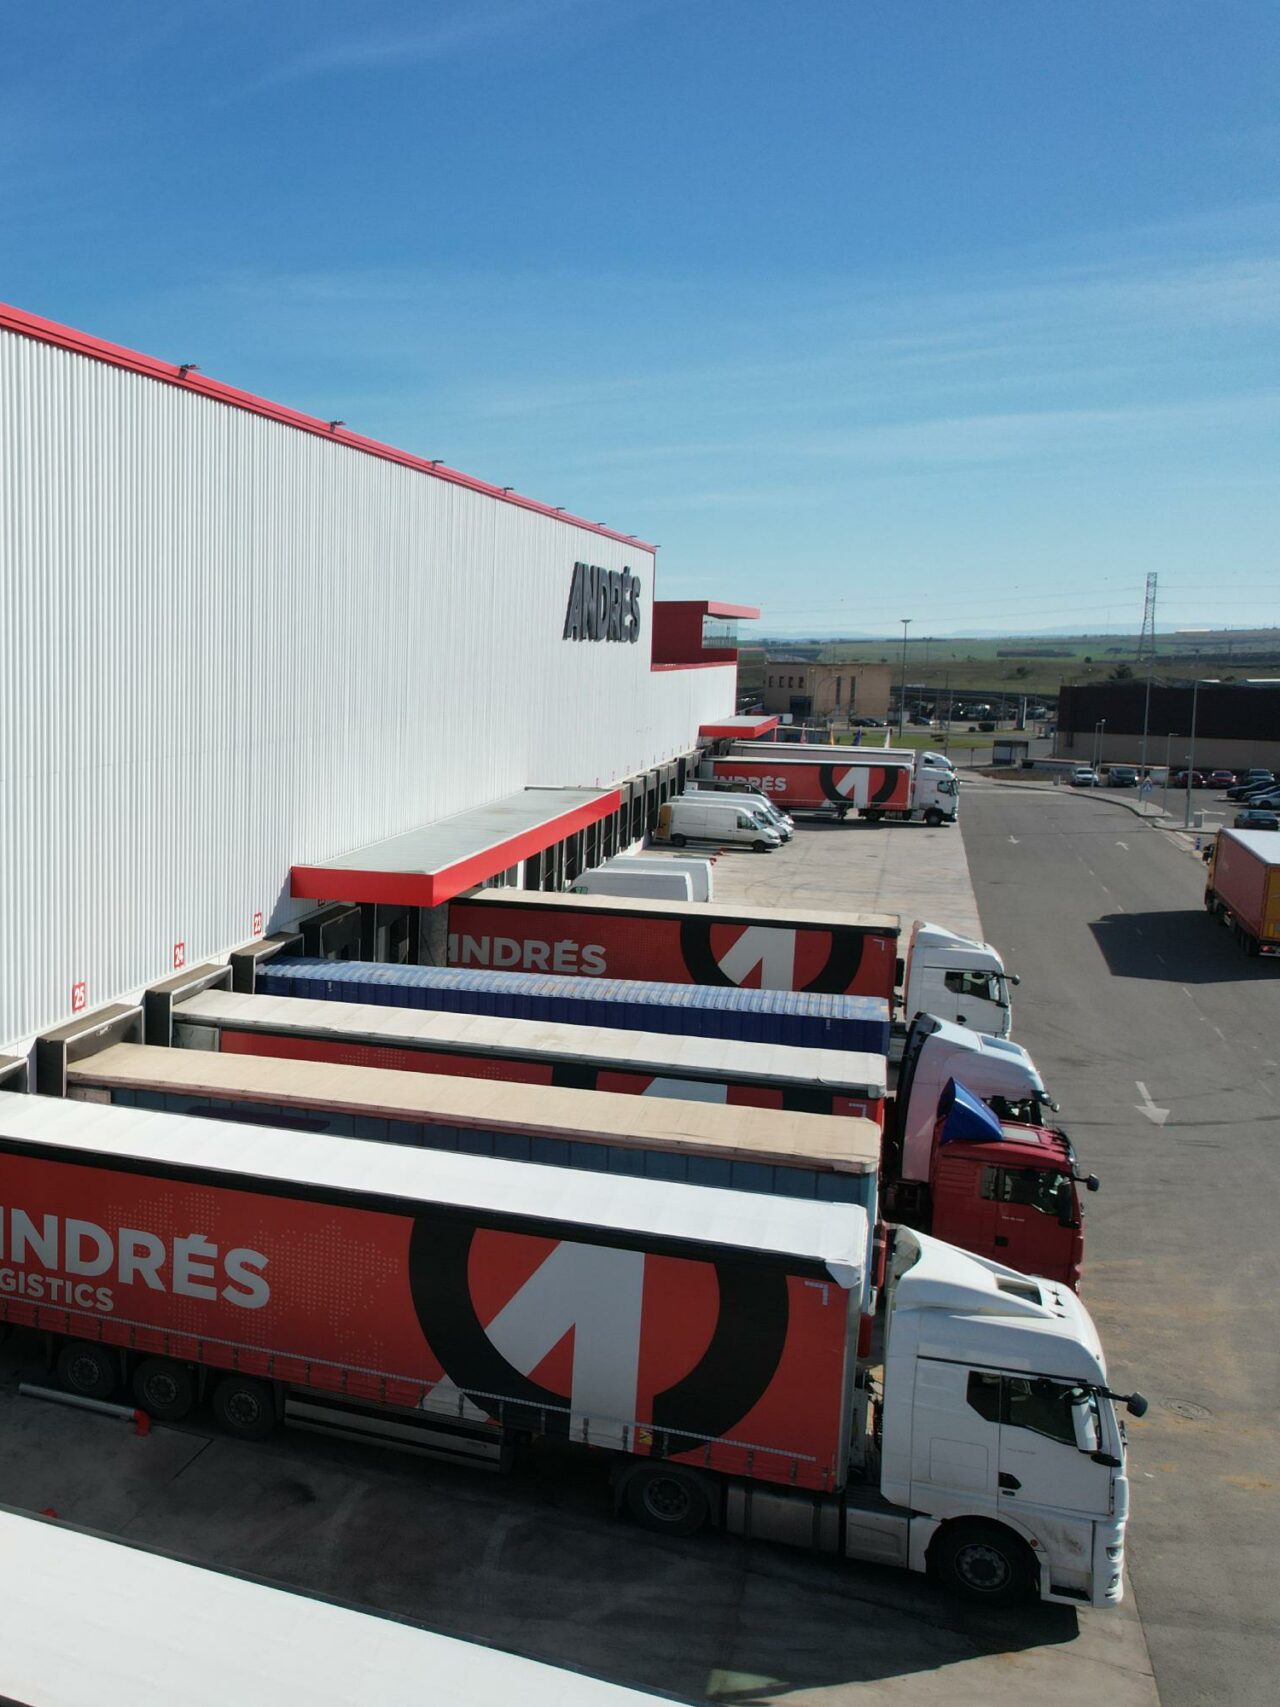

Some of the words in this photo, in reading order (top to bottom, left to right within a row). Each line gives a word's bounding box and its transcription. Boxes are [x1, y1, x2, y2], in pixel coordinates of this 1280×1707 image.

[562, 561, 641, 644] ANDRÉS
[254, 914, 262, 933] 23
[174, 945, 184, 966] 24
[74, 985, 85, 1009] 25
